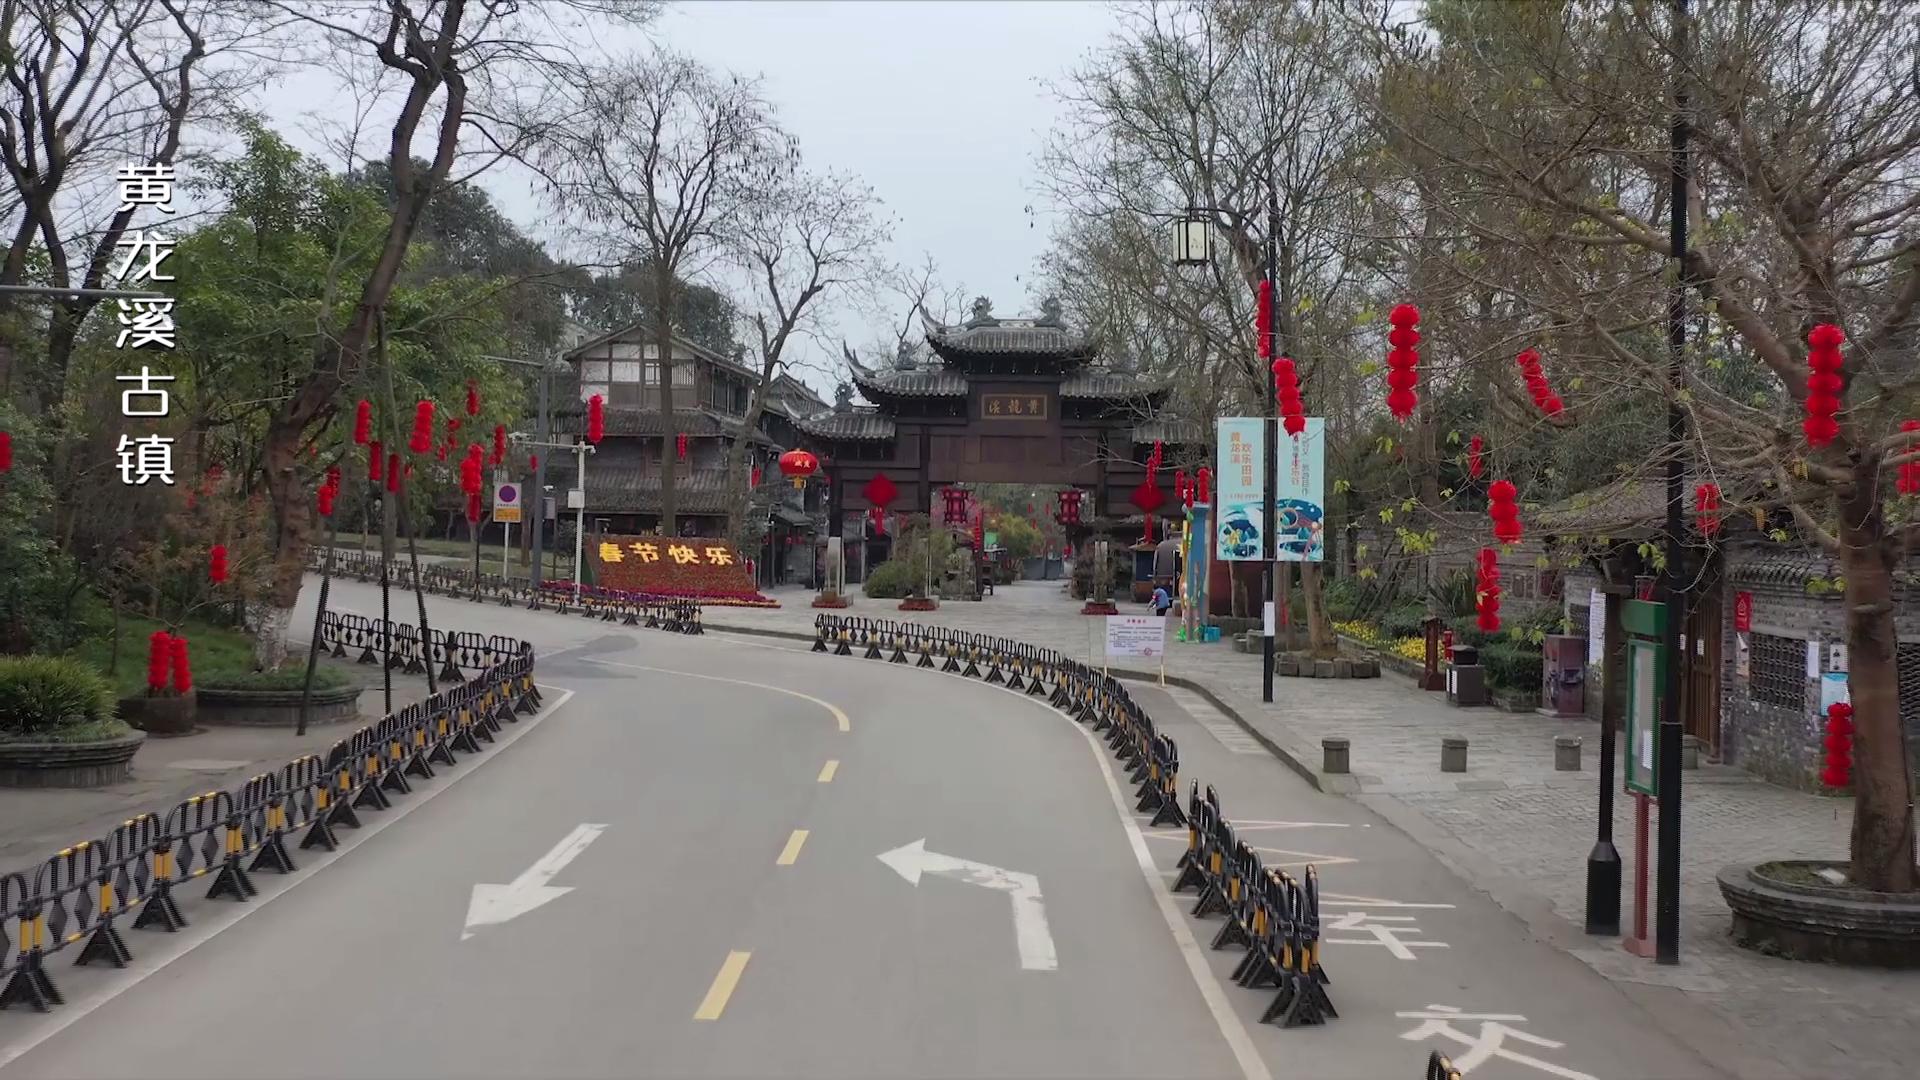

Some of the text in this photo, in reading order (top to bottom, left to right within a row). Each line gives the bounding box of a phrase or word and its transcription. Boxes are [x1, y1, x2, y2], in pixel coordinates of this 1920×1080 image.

[1241, 443, 1253, 486] 欢乐田园
[599, 542, 733, 565] 春节快乐
